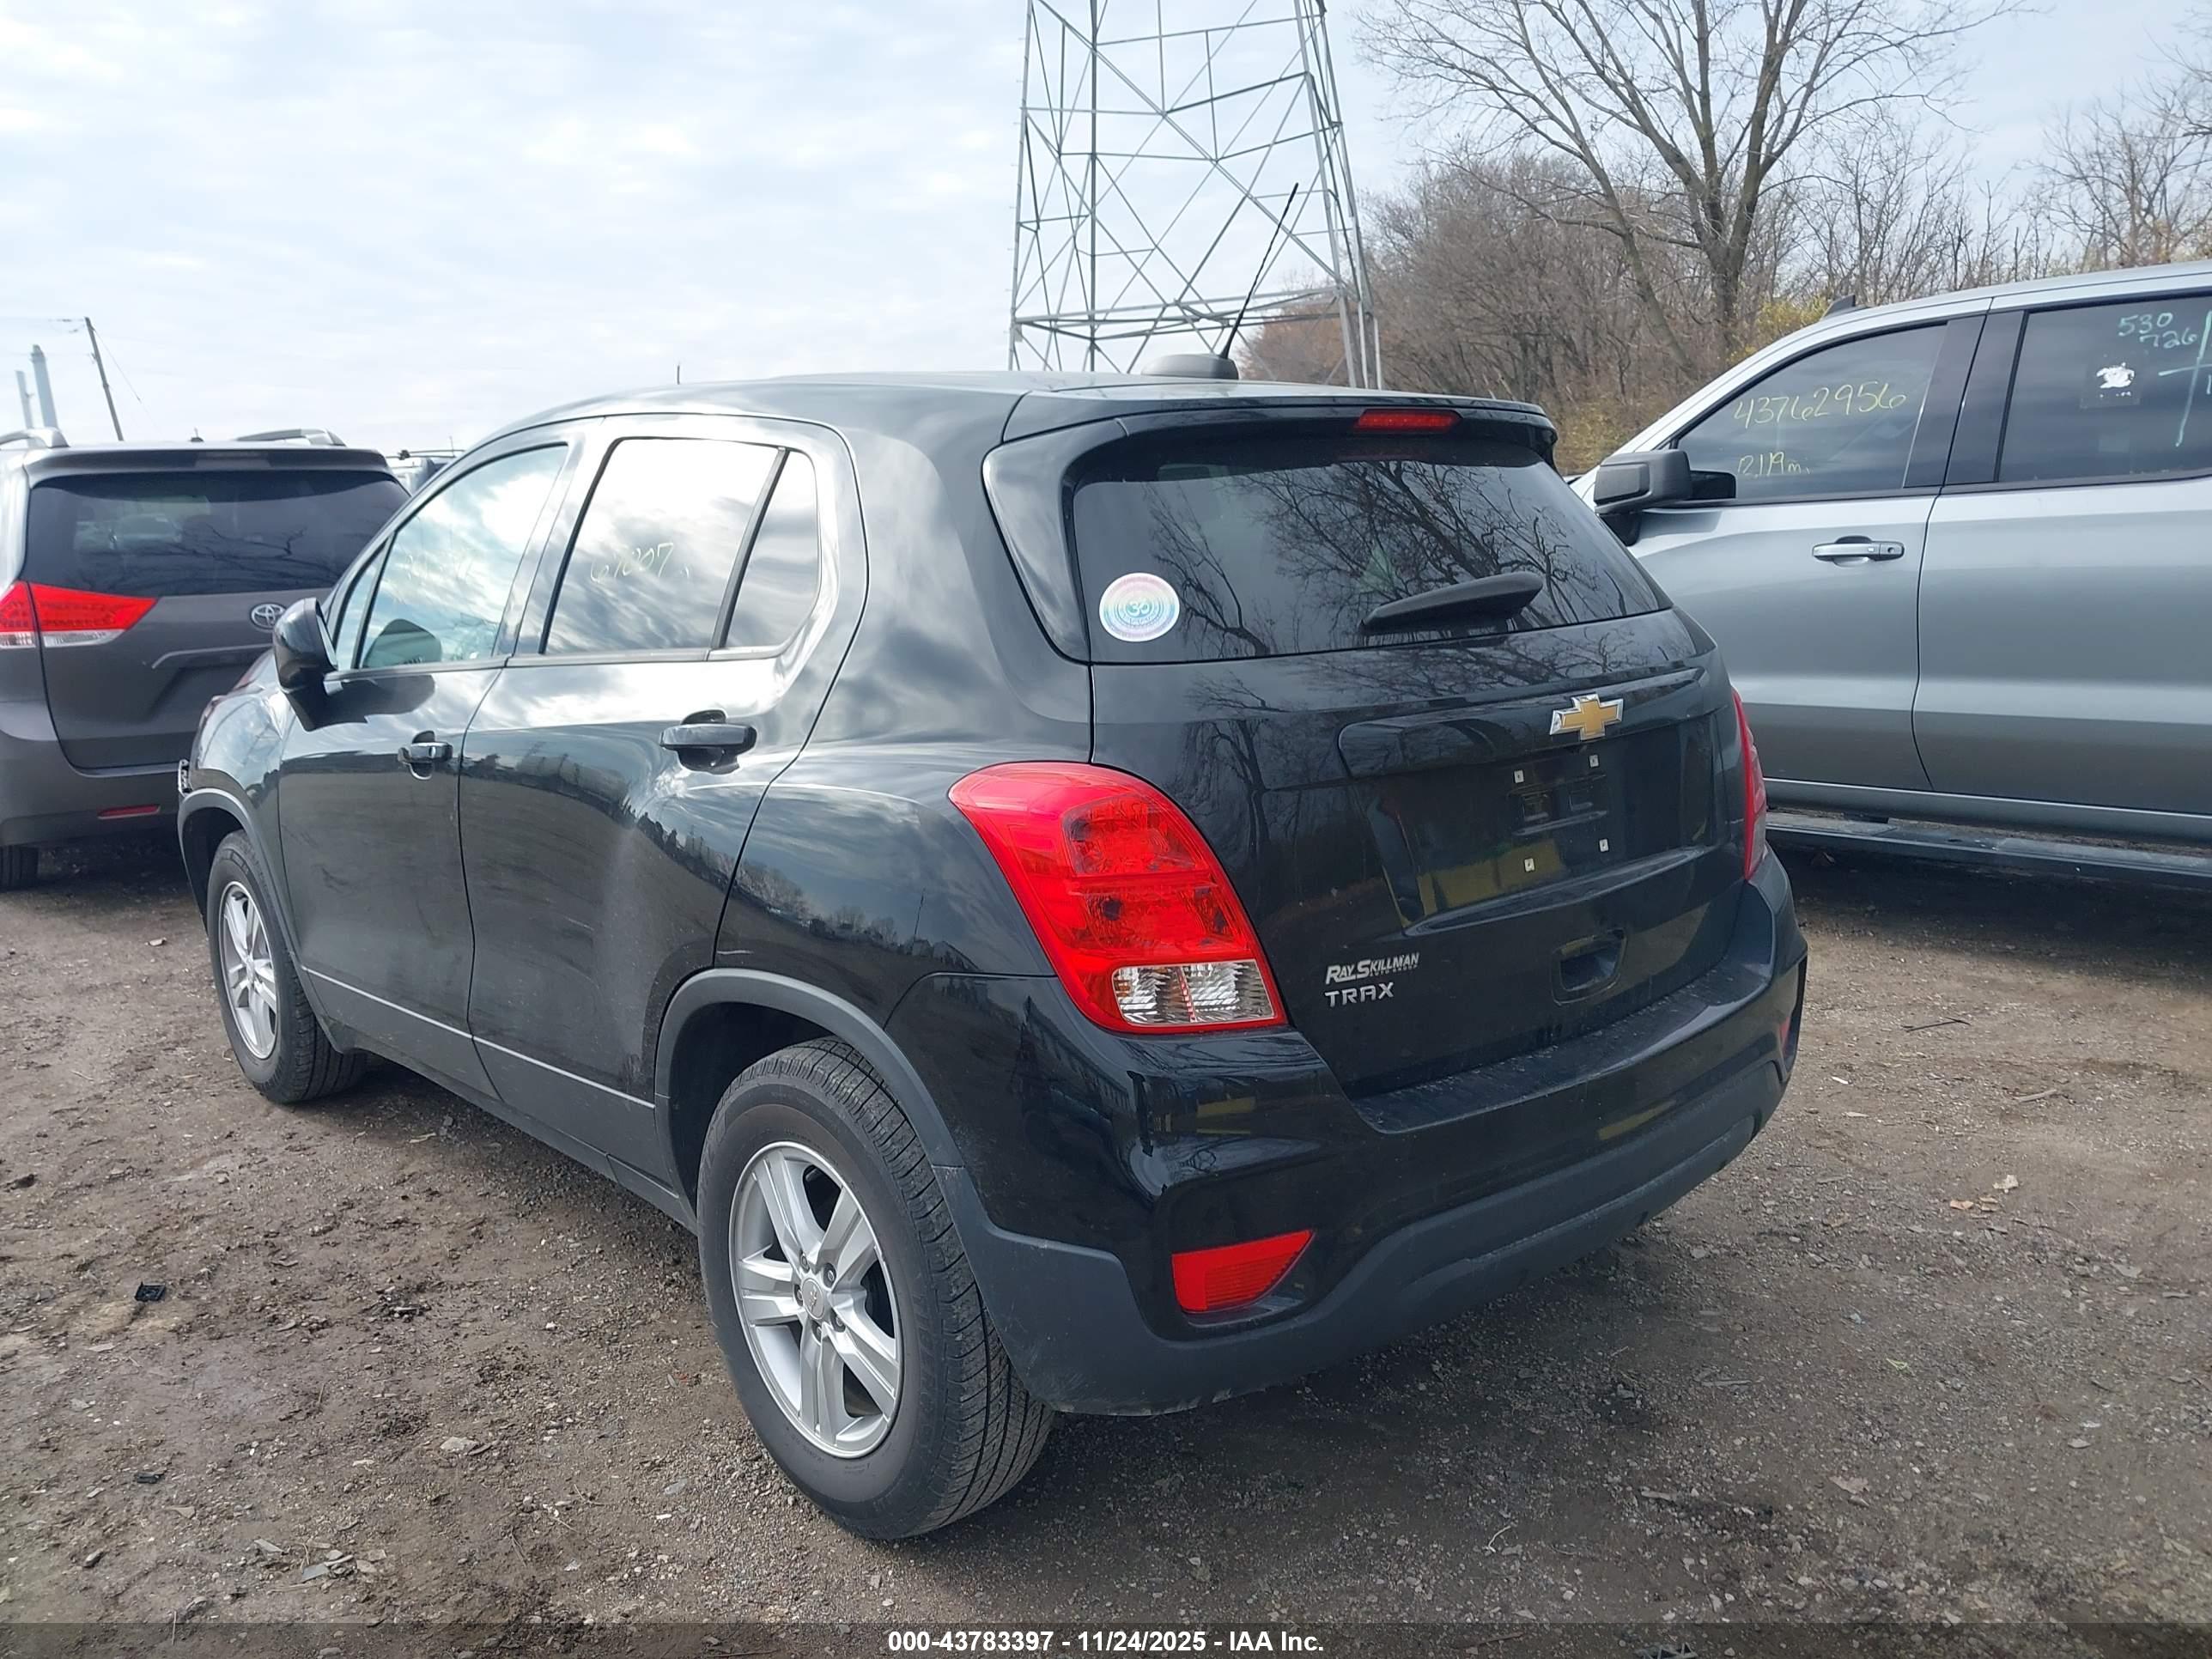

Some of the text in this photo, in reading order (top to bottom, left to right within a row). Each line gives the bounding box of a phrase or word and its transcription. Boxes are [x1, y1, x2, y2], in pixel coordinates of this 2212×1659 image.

[2118, 312, 2173, 337] 530
[2139, 327, 2198, 349] 726
[1733, 380, 1907, 429] 43762956
[1325, 951, 1420, 985] RAY SKILLMAN
[1324, 981, 1395, 1007] TRAX
